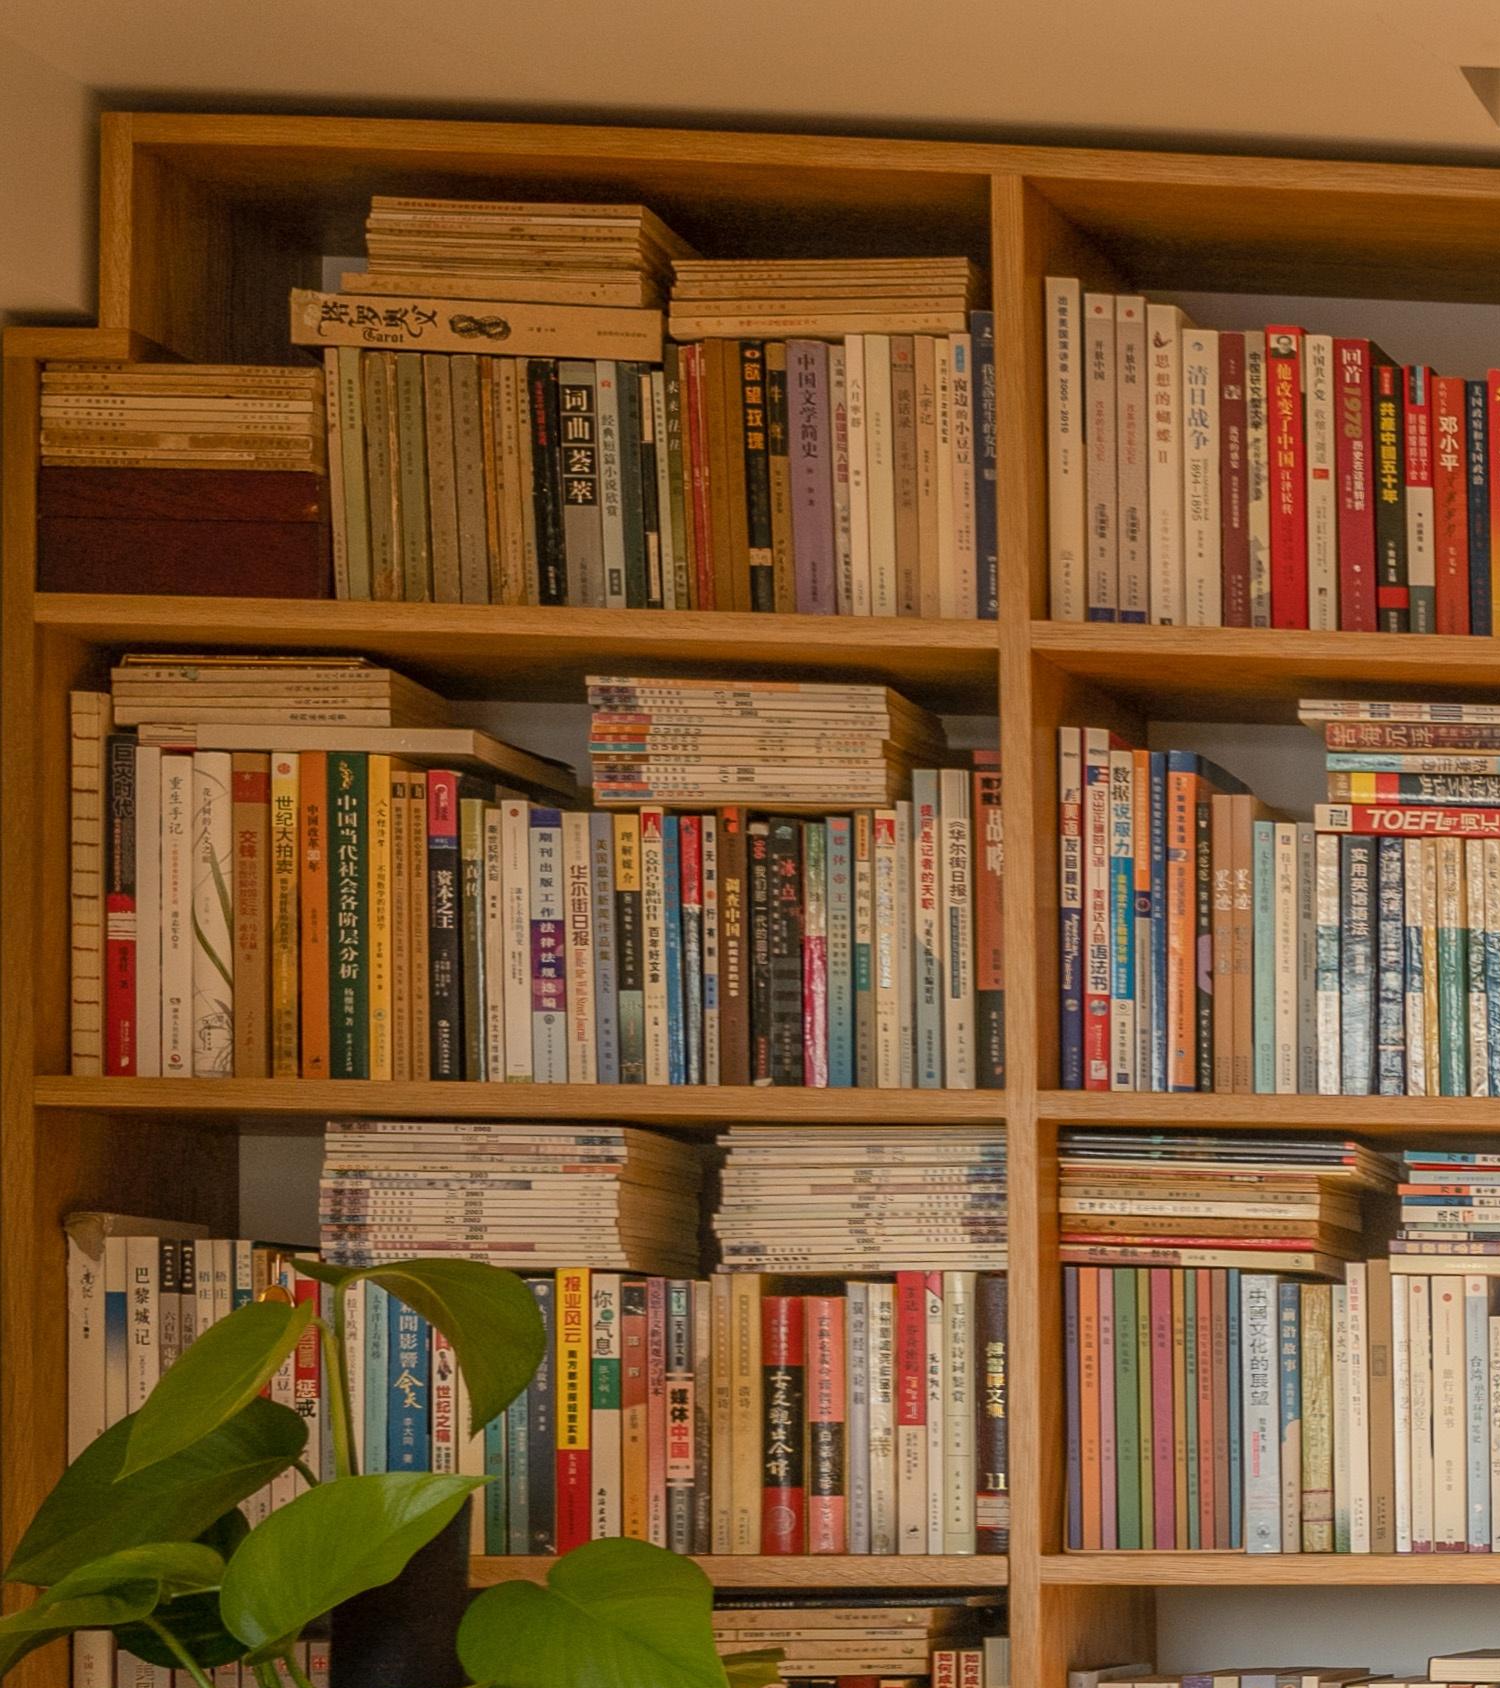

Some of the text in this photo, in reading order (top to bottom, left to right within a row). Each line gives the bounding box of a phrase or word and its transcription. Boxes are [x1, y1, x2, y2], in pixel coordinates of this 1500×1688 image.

[363, 330, 404, 344] Tarot
[565, 388, 594, 502] 词曲荟萃
[1439, 416, 1459, 471] 邓小平
[276, 797, 293, 875] 世纪大拍卖
[1114, 766, 1131, 858] 数据说服力
[1366, 809, 1450, 831] TOEFL
[338, 797, 360, 979] 中国当代社会各阶层分析
[539, 832, 555, 917] 期刊出版工作
[1351, 849, 1372, 937] 实用英语语法
[136, 1267, 152, 1347] 巴黎城记
[297, 1378, 317, 1419] 惩戒
